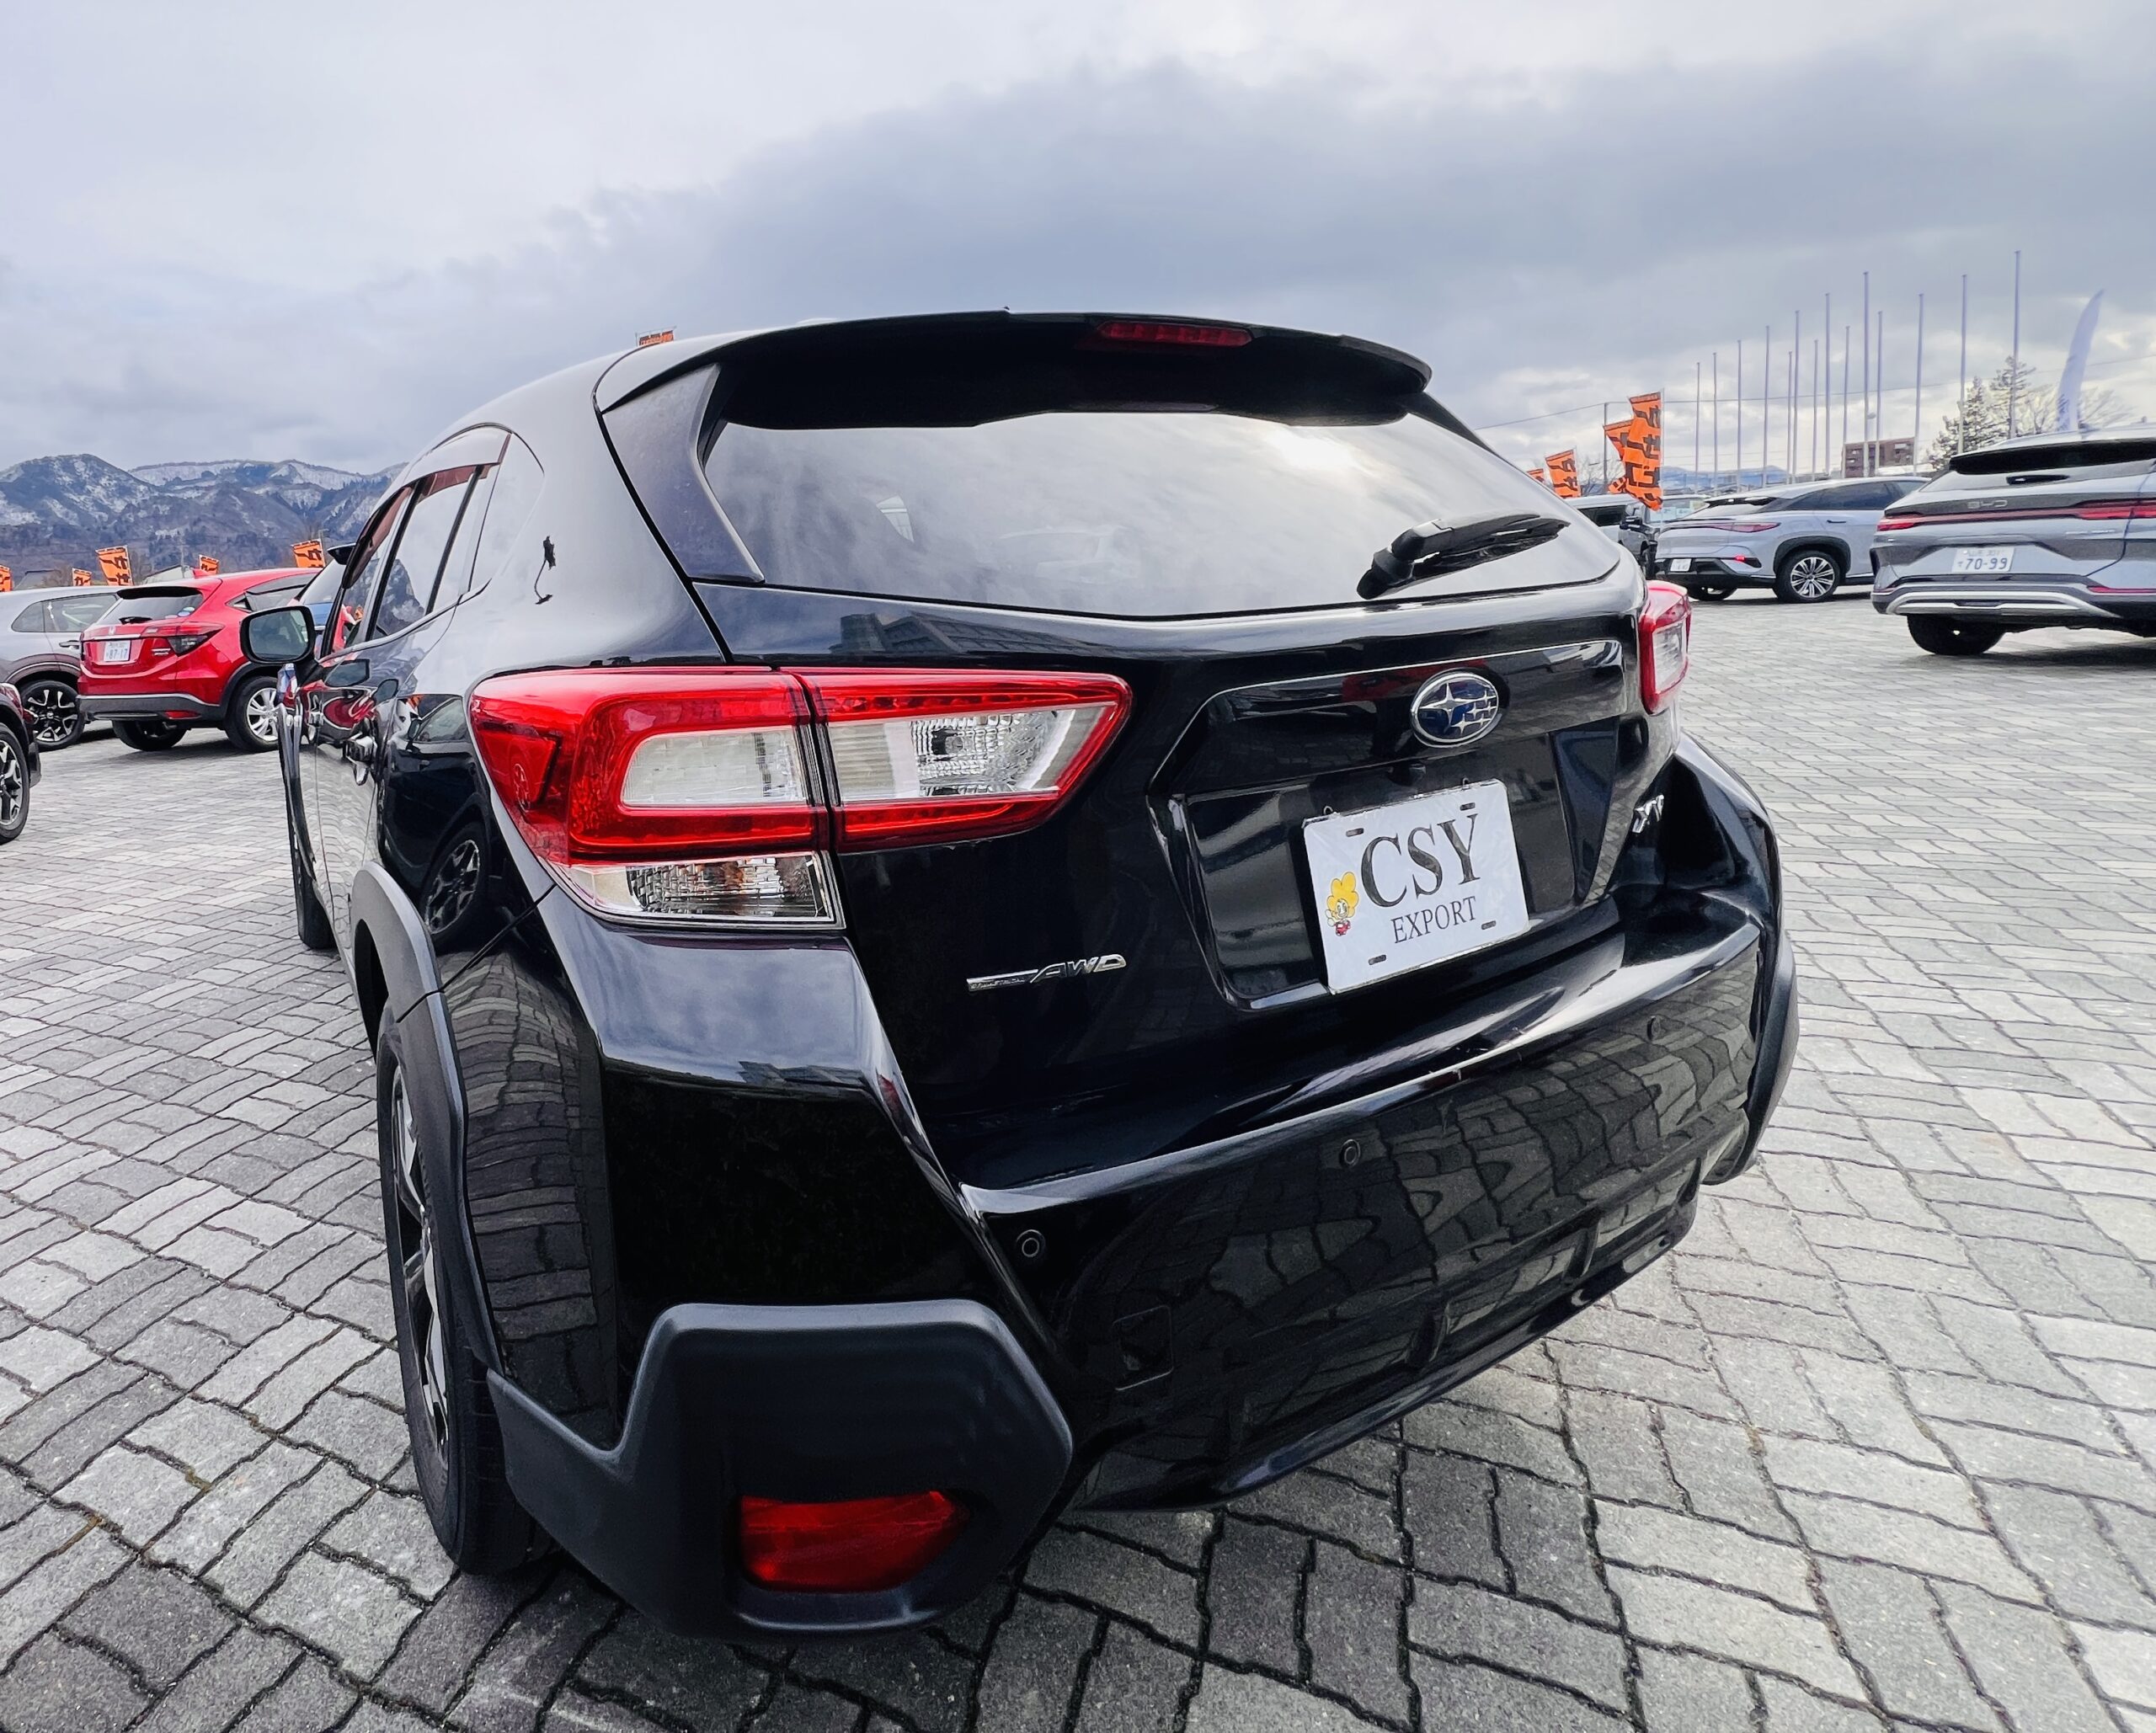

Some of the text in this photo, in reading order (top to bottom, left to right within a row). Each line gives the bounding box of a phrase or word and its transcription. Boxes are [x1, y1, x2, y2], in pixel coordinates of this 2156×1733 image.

[1965, 557, 2008, 570] 70-99
[1361, 813, 1480, 907] CSY
[1390, 897, 1476, 943] EXPORT
[1031, 954, 1126, 983] AWD
